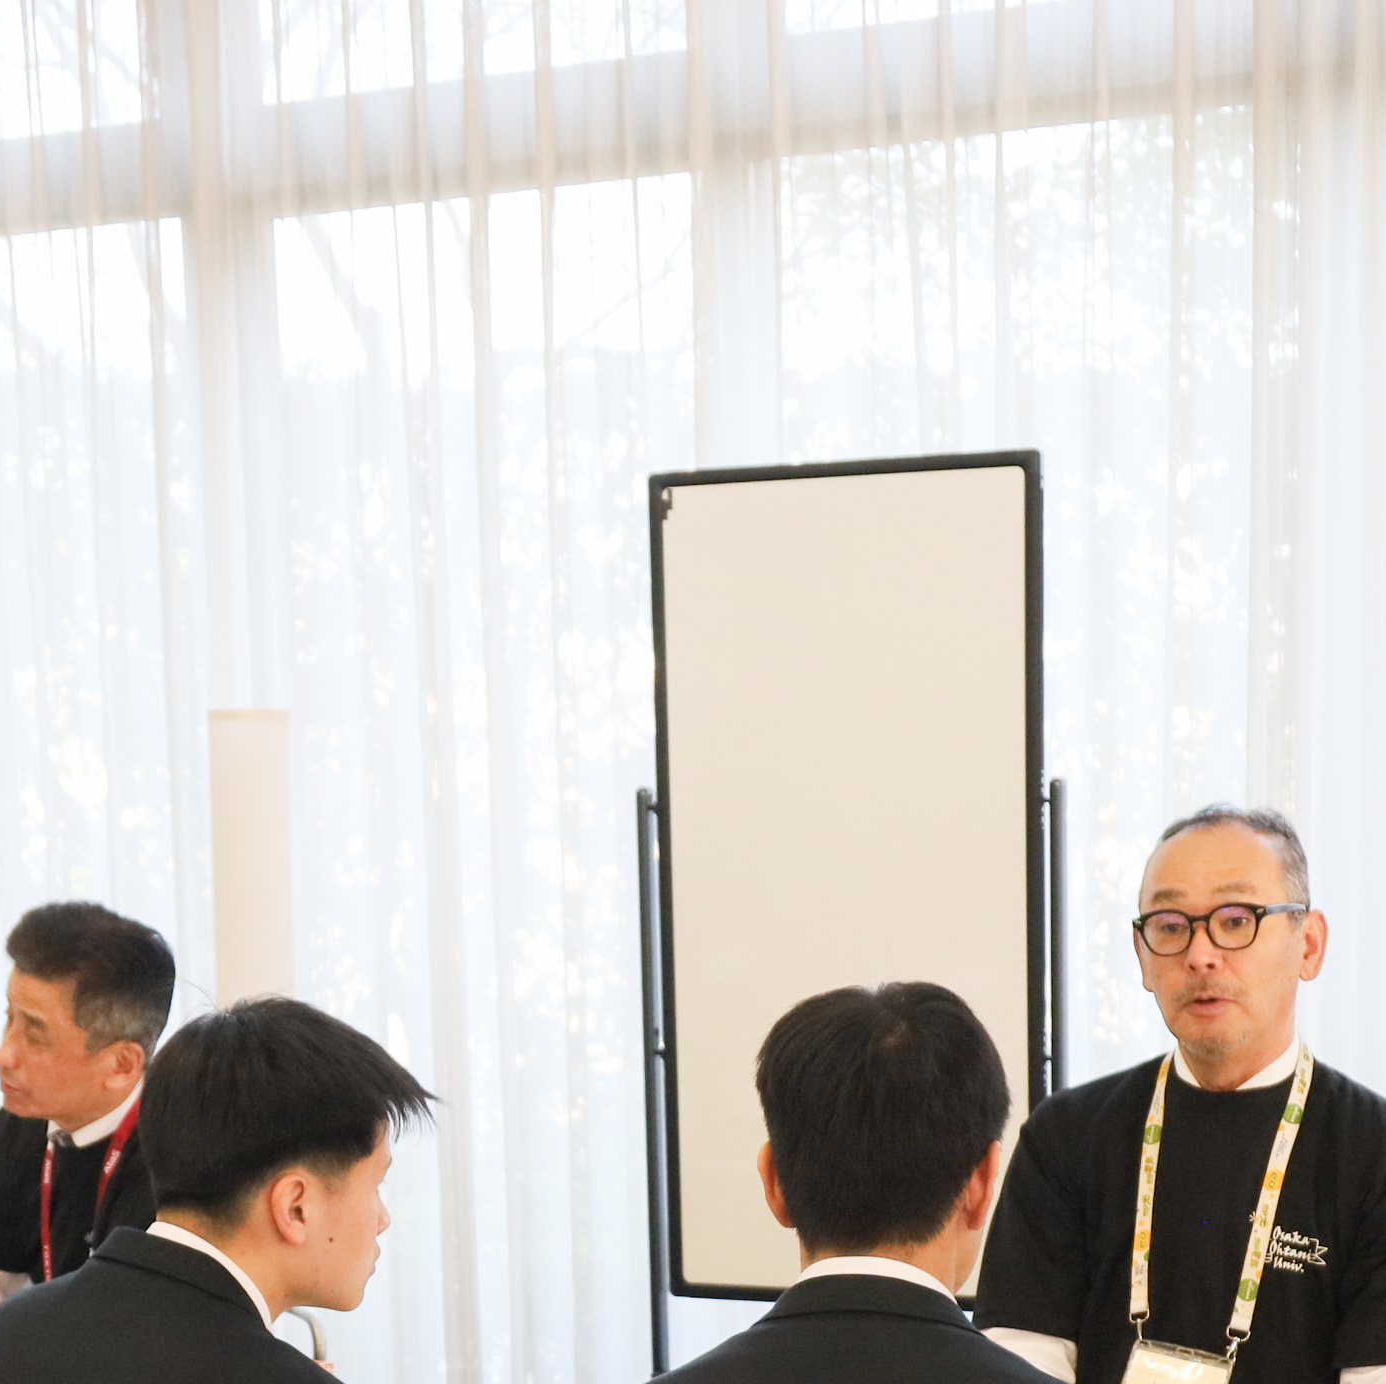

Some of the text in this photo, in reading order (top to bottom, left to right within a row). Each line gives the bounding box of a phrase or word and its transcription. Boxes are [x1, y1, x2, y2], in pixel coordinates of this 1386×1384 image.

[1272, 1225, 1311, 1246] Osaka
[1269, 1240, 1313, 1261] Ohtani
[1272, 1256, 1305, 1273] Univ.
